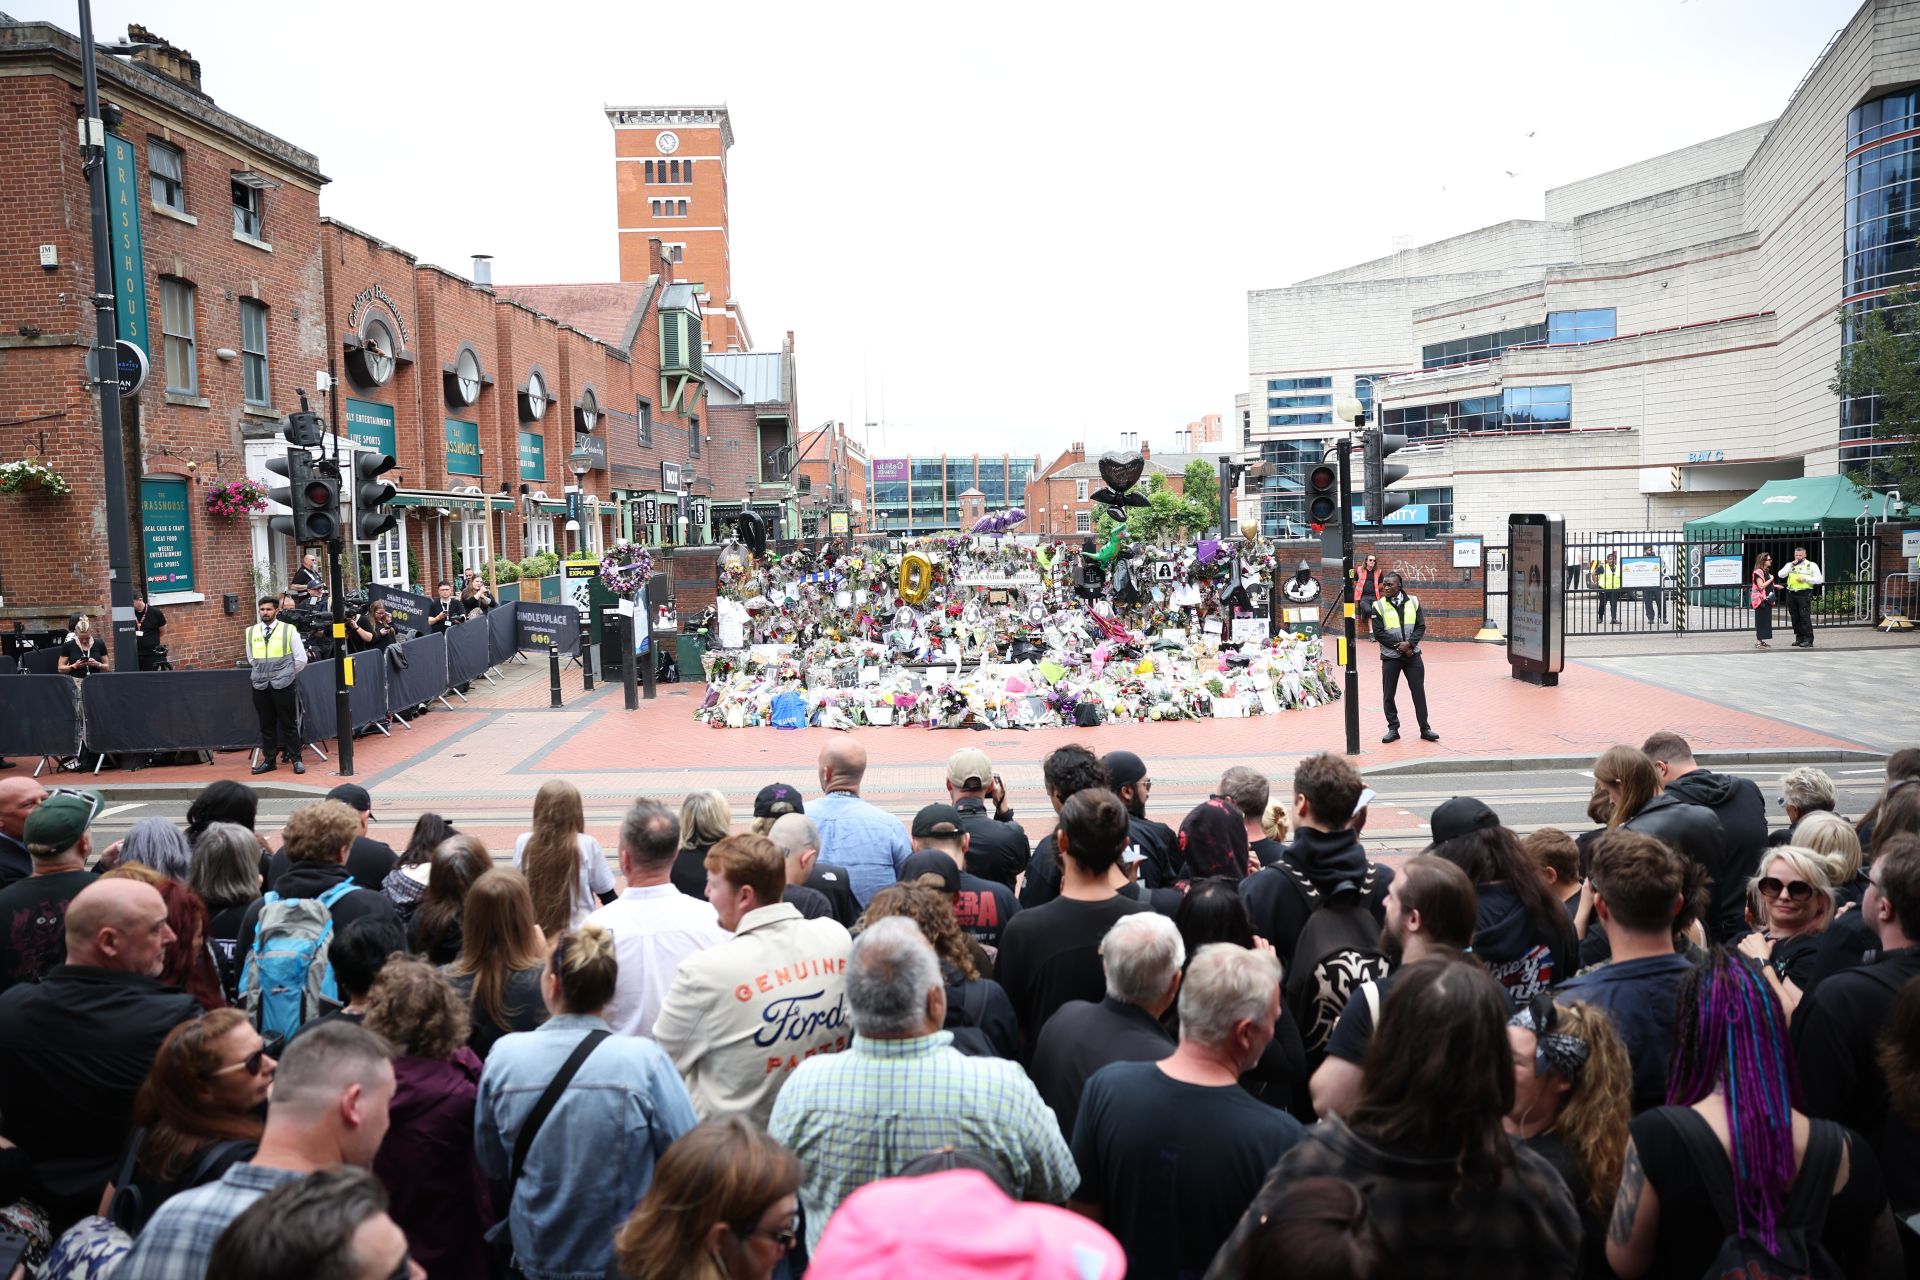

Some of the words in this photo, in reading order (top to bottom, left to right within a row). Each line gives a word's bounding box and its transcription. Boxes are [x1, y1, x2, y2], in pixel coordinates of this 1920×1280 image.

[117, 145, 138, 338] BRASSHOUS
[348, 287, 374, 328] Celebrity
[375, 284, 409, 343] Restaurant
[356, 414, 392, 427] ENTERTAINMENT
[363, 435, 380, 446] SPORTS
[580, 435, 604, 456] Celebrity
[446, 441, 476, 456] ASSHOUSE
[1688, 451, 1711, 463] BAY
[1714, 449, 1724, 461] C
[666, 469, 679, 484] BOX
[143, 500, 184, 511] RASSHOUSE
[421, 499, 448, 507] TRADITIONAL
[646, 501, 654, 521] BOX
[1353, 510, 1417, 521] SERITY
[154, 574, 168, 582] sports
[386, 593, 401, 604] SHARE
[401, 597, 415, 607] YOUR
[384, 600, 423, 616] RINDLEYMOMENT
[517, 611, 567, 626] RINDLEYPLACE
[735, 957, 847, 1003] GENUINE
[754, 989, 846, 1048] Ford
